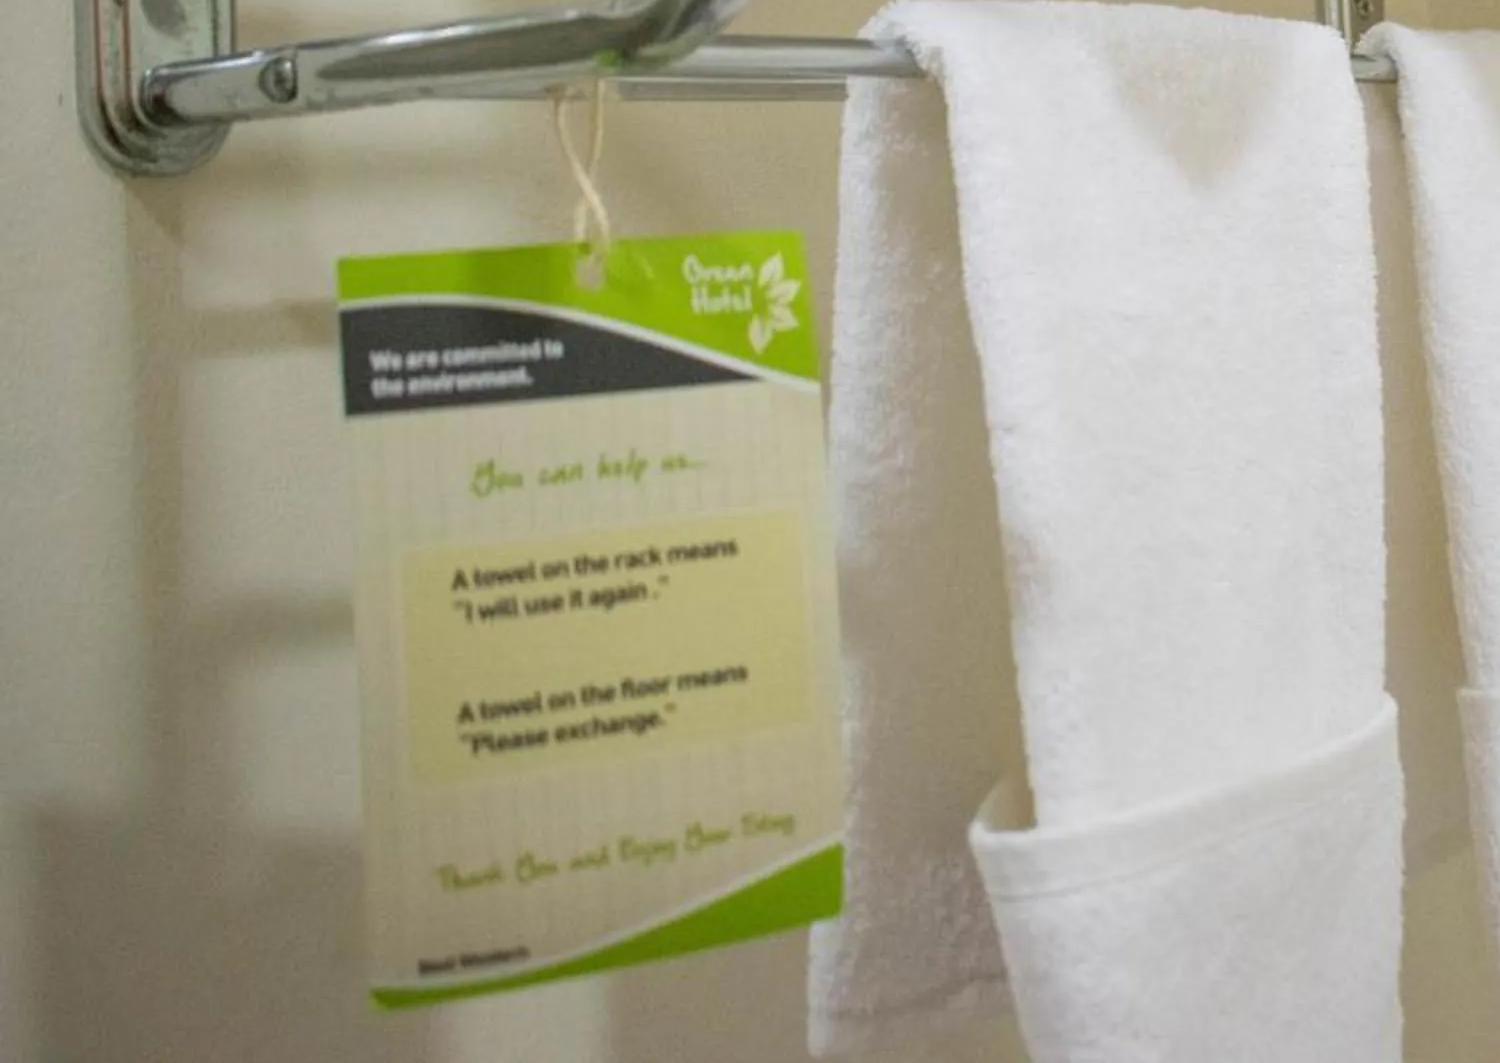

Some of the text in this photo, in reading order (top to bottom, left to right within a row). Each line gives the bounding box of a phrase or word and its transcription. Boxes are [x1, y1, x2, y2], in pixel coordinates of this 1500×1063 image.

[369, 339, 564, 372] We are committed to
[371, 377, 404, 399] the
[451, 539, 738, 591] A towel on the rack means
[477, 595, 519, 623] will
[523, 594, 564, 617] use
[569, 588, 583, 610] it
[457, 665, 749, 724] A towel on the floor means
